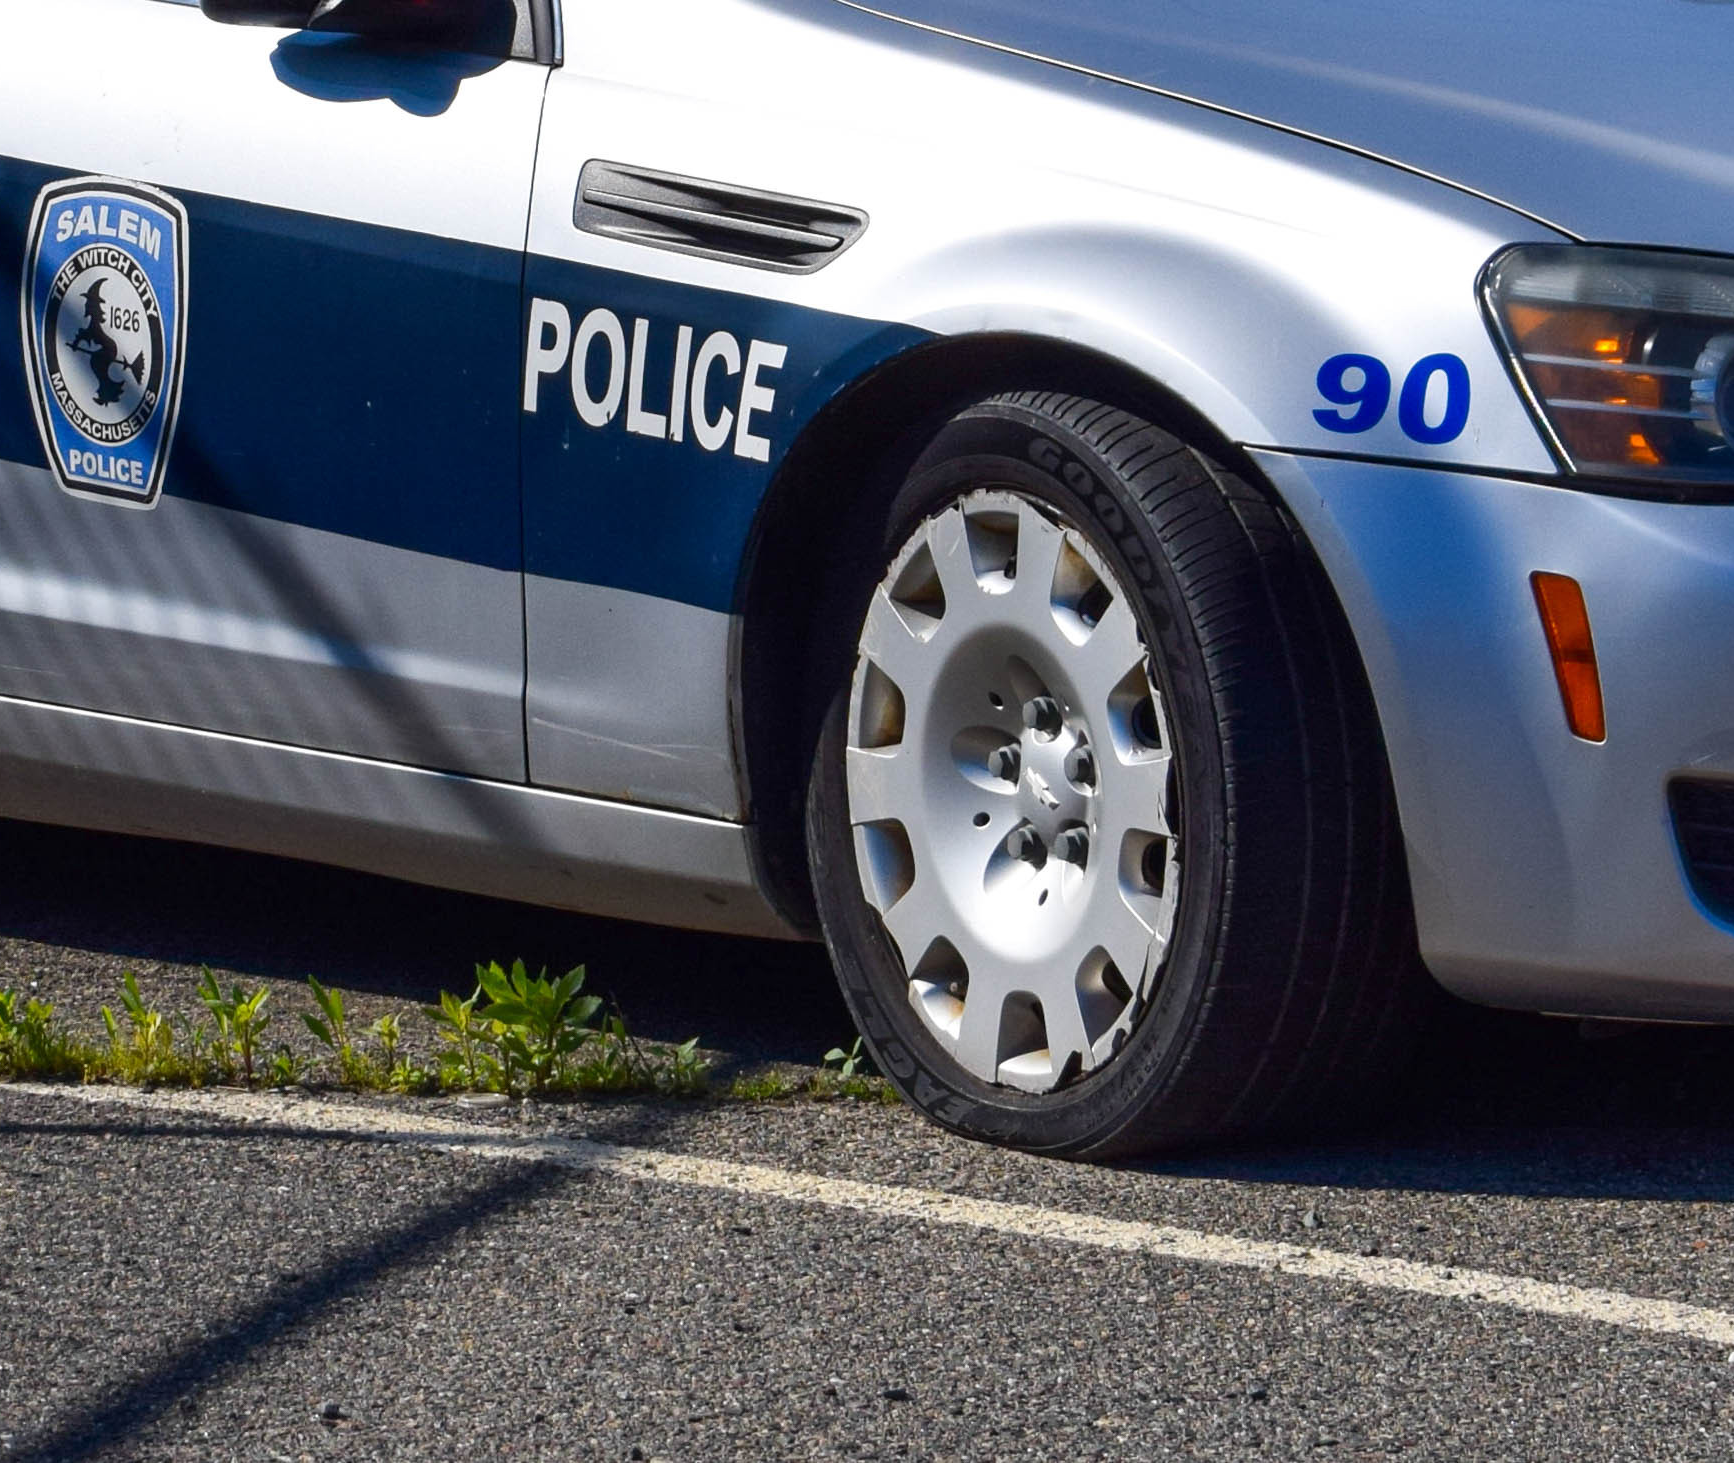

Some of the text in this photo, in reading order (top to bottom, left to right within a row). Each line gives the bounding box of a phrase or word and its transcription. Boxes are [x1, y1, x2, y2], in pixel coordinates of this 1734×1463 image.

[56, 204, 162, 261] SALEM
[51, 247, 159, 318] THE WITCH CITY
[109, 306, 141, 333] 1626
[50, 371, 157, 442] MASSACHUSETTS
[523, 296, 789, 463] POLICE
[1311, 352, 1471, 446] 90
[69, 448, 144, 486] POLICE
